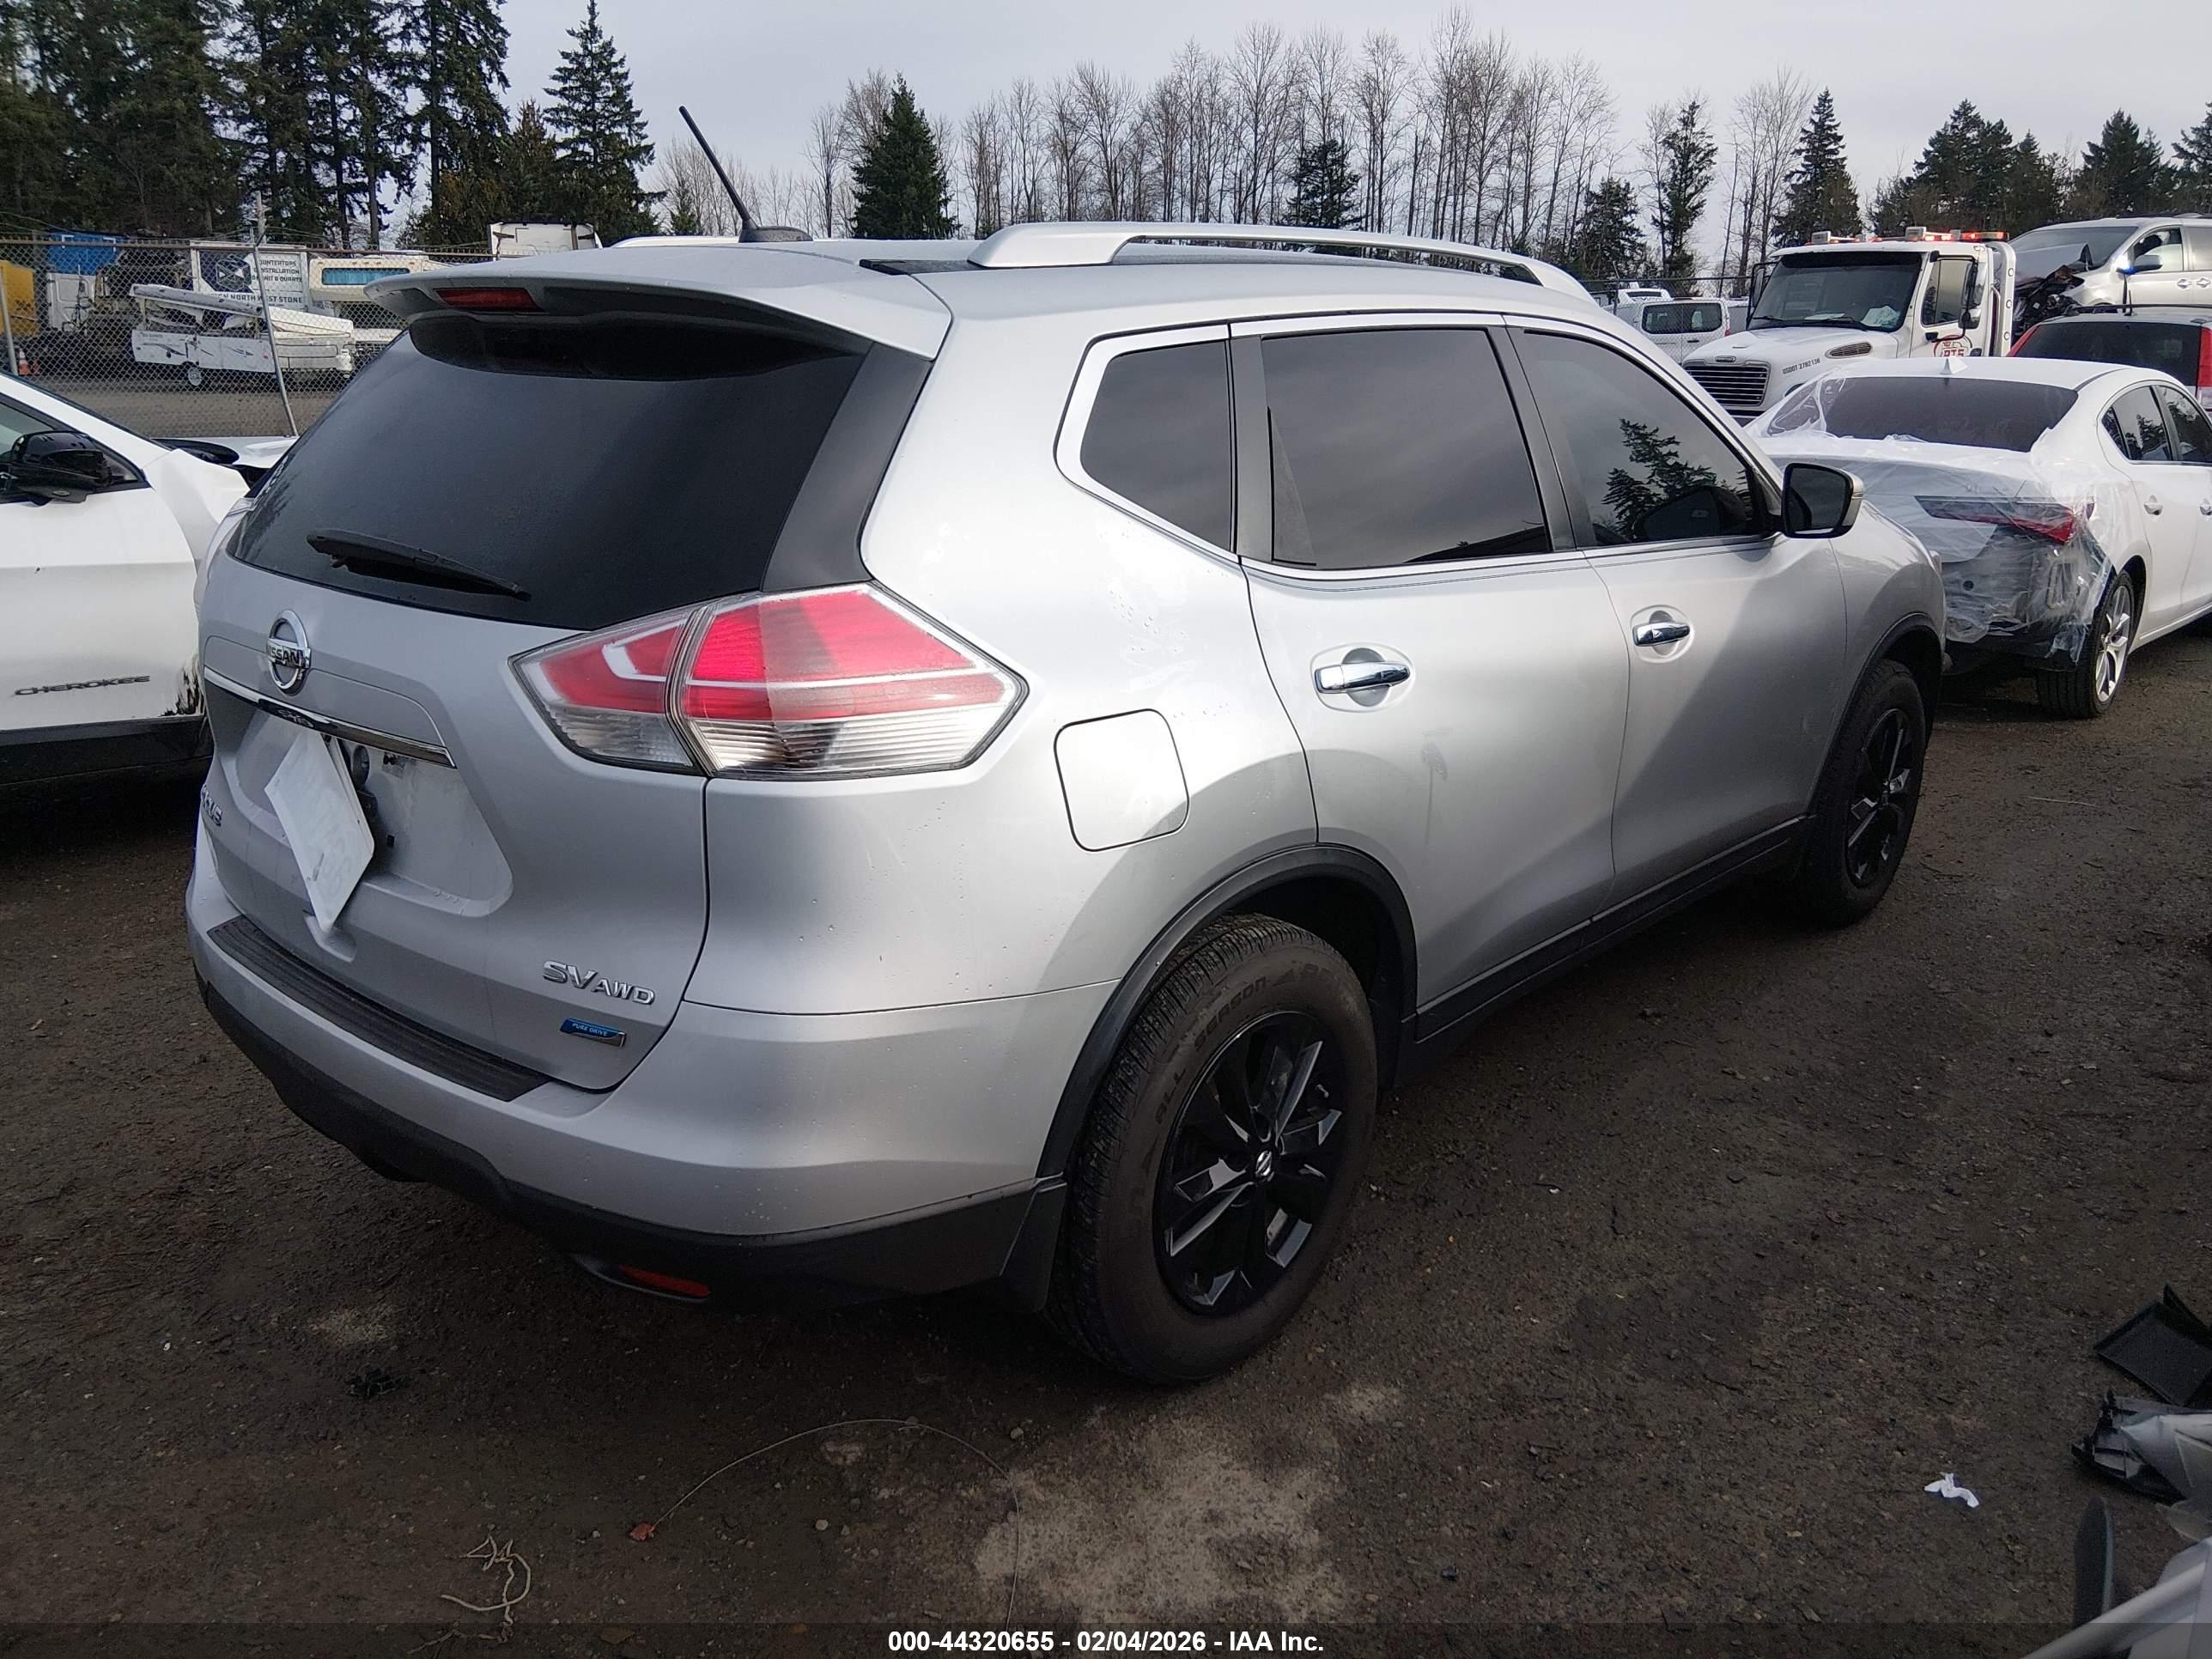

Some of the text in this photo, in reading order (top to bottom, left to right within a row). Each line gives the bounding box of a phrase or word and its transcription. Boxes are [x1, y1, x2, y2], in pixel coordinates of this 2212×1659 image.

[15, 675, 150, 696] CHEROKEE
[543, 960, 655, 1005] SV AWD
[571, 1023, 609, 1036] PURE DRIVE
